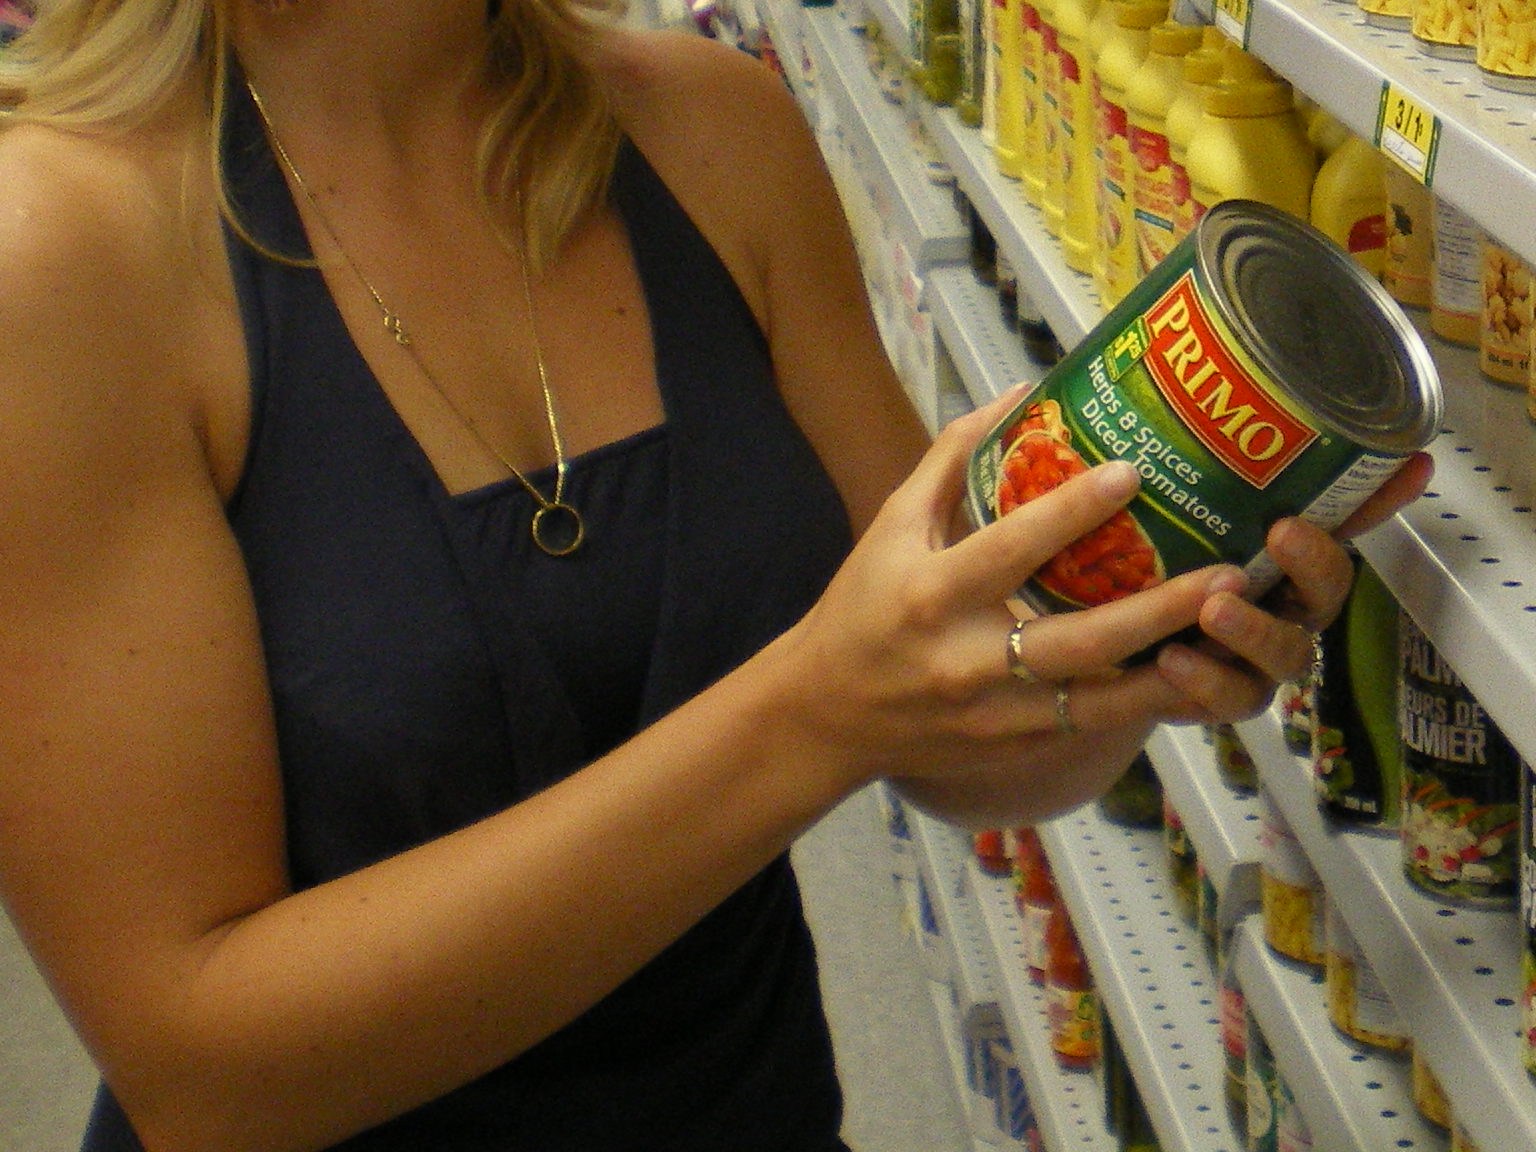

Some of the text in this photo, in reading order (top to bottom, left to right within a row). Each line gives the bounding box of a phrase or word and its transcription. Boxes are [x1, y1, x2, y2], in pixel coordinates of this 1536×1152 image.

[1088, 354, 1203, 486] Herbs & Spices
[1151, 294, 1286, 463] PRIMO
[1081, 397, 1233, 537] Diced Tomatoes
